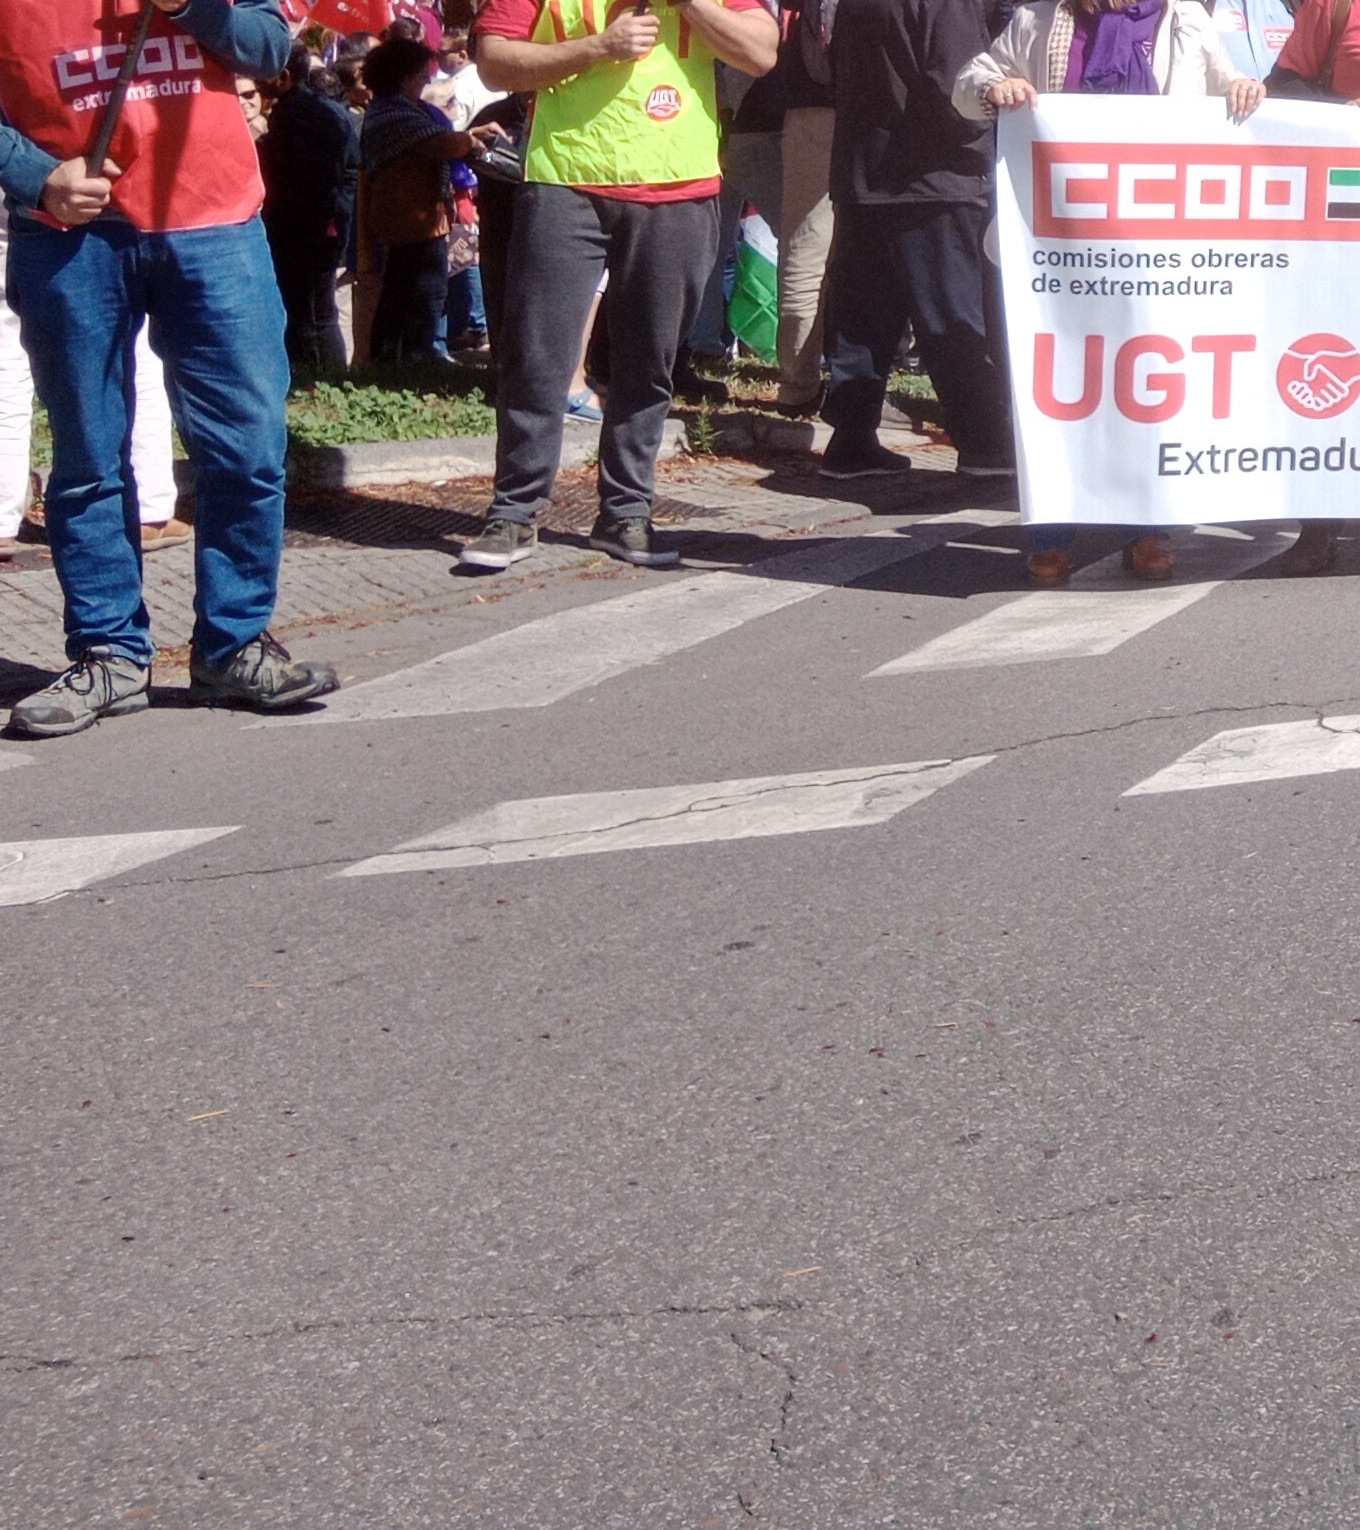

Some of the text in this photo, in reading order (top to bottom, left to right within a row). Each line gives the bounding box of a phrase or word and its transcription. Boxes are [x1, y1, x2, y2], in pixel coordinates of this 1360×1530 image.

[72, 78, 201, 112] extrmadura
[650, 89, 677, 105] UGT
[1050, 163, 1307, 220] CCOO
[1031, 247, 1290, 269] comisiones obreras
[1031, 274, 1234, 296] de extremadura
[1032, 332, 1257, 424] UGT
